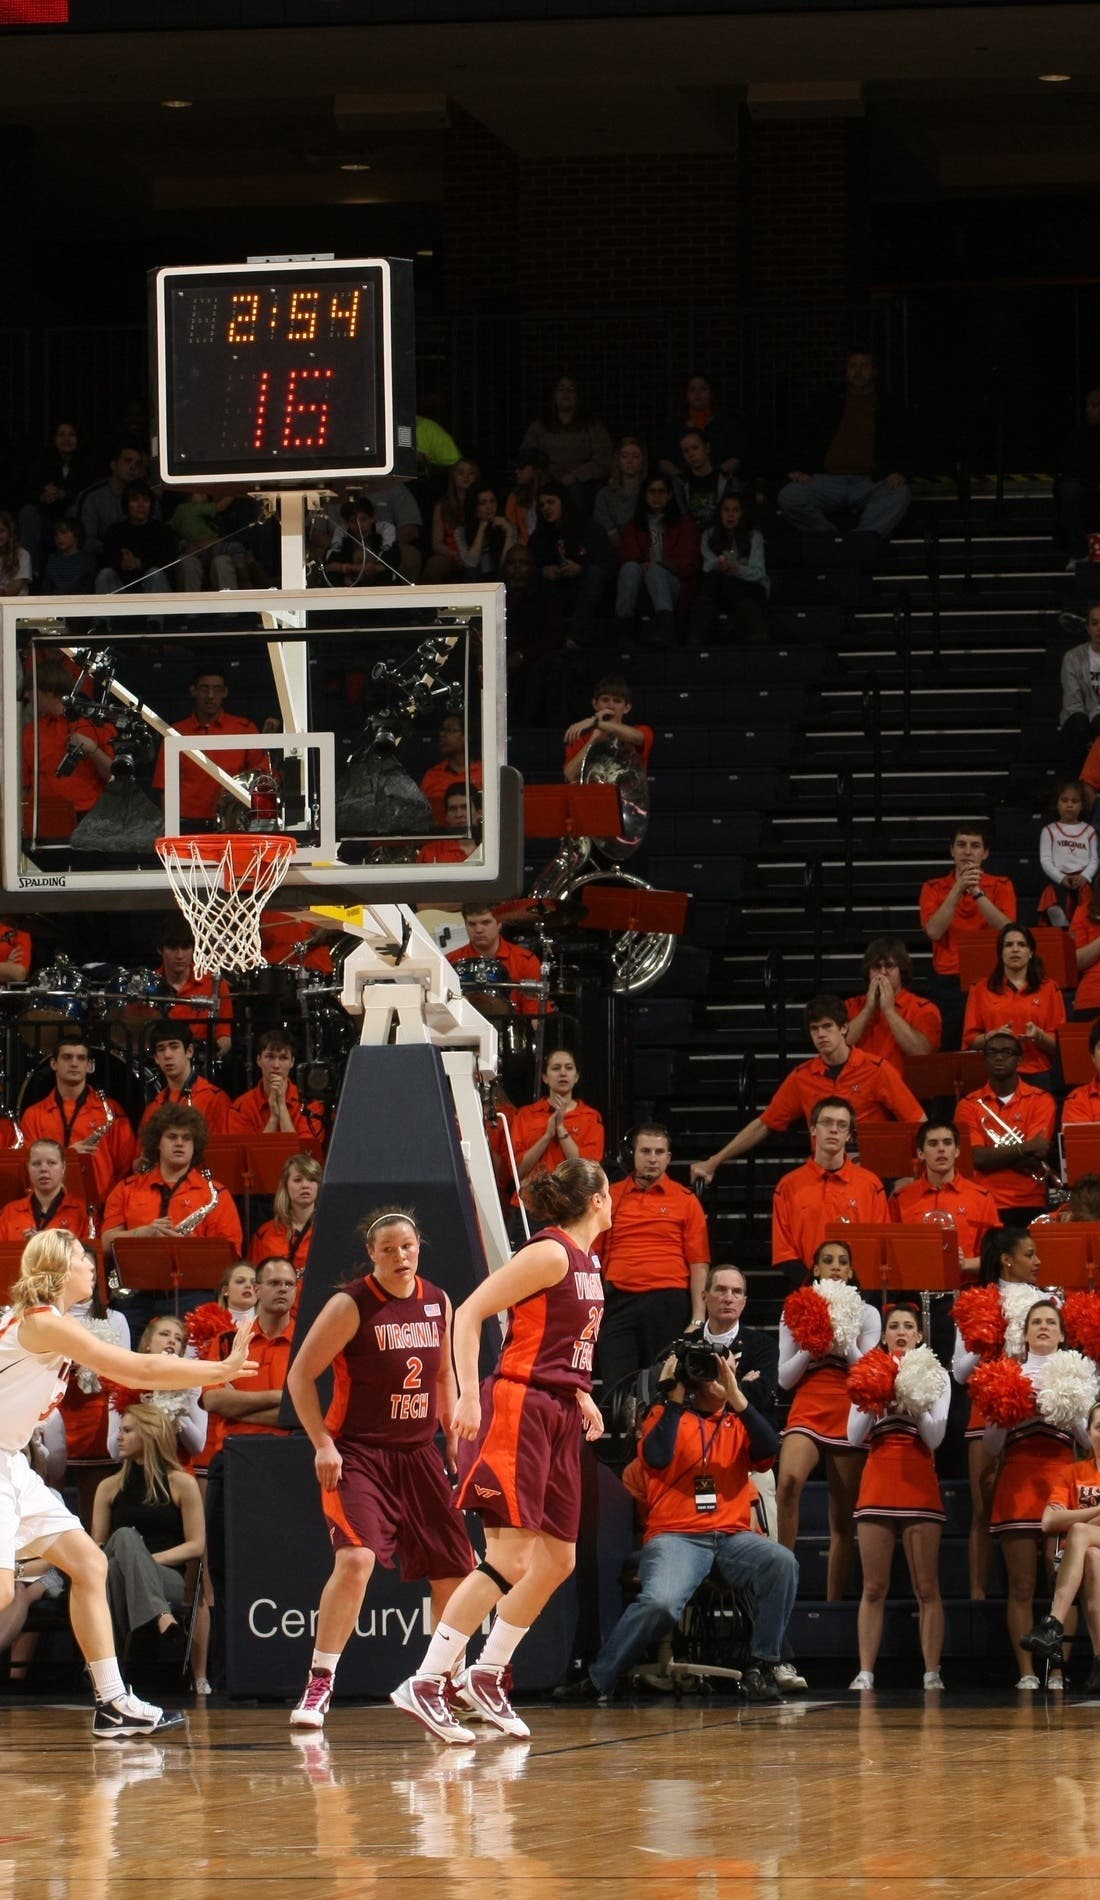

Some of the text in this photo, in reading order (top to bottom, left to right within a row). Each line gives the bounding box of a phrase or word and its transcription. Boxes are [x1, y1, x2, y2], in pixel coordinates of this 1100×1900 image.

[228, 290, 359, 342] 2:54
[253, 368, 334, 449] 16
[1056, 839, 1087, 850] VIRGINIA
[19, 876, 66, 888] SPALDING
[374, 1321, 440, 1350] VIRGINIA
[403, 1356, 423, 1389] 2
[390, 1393, 429, 1419] TECH
